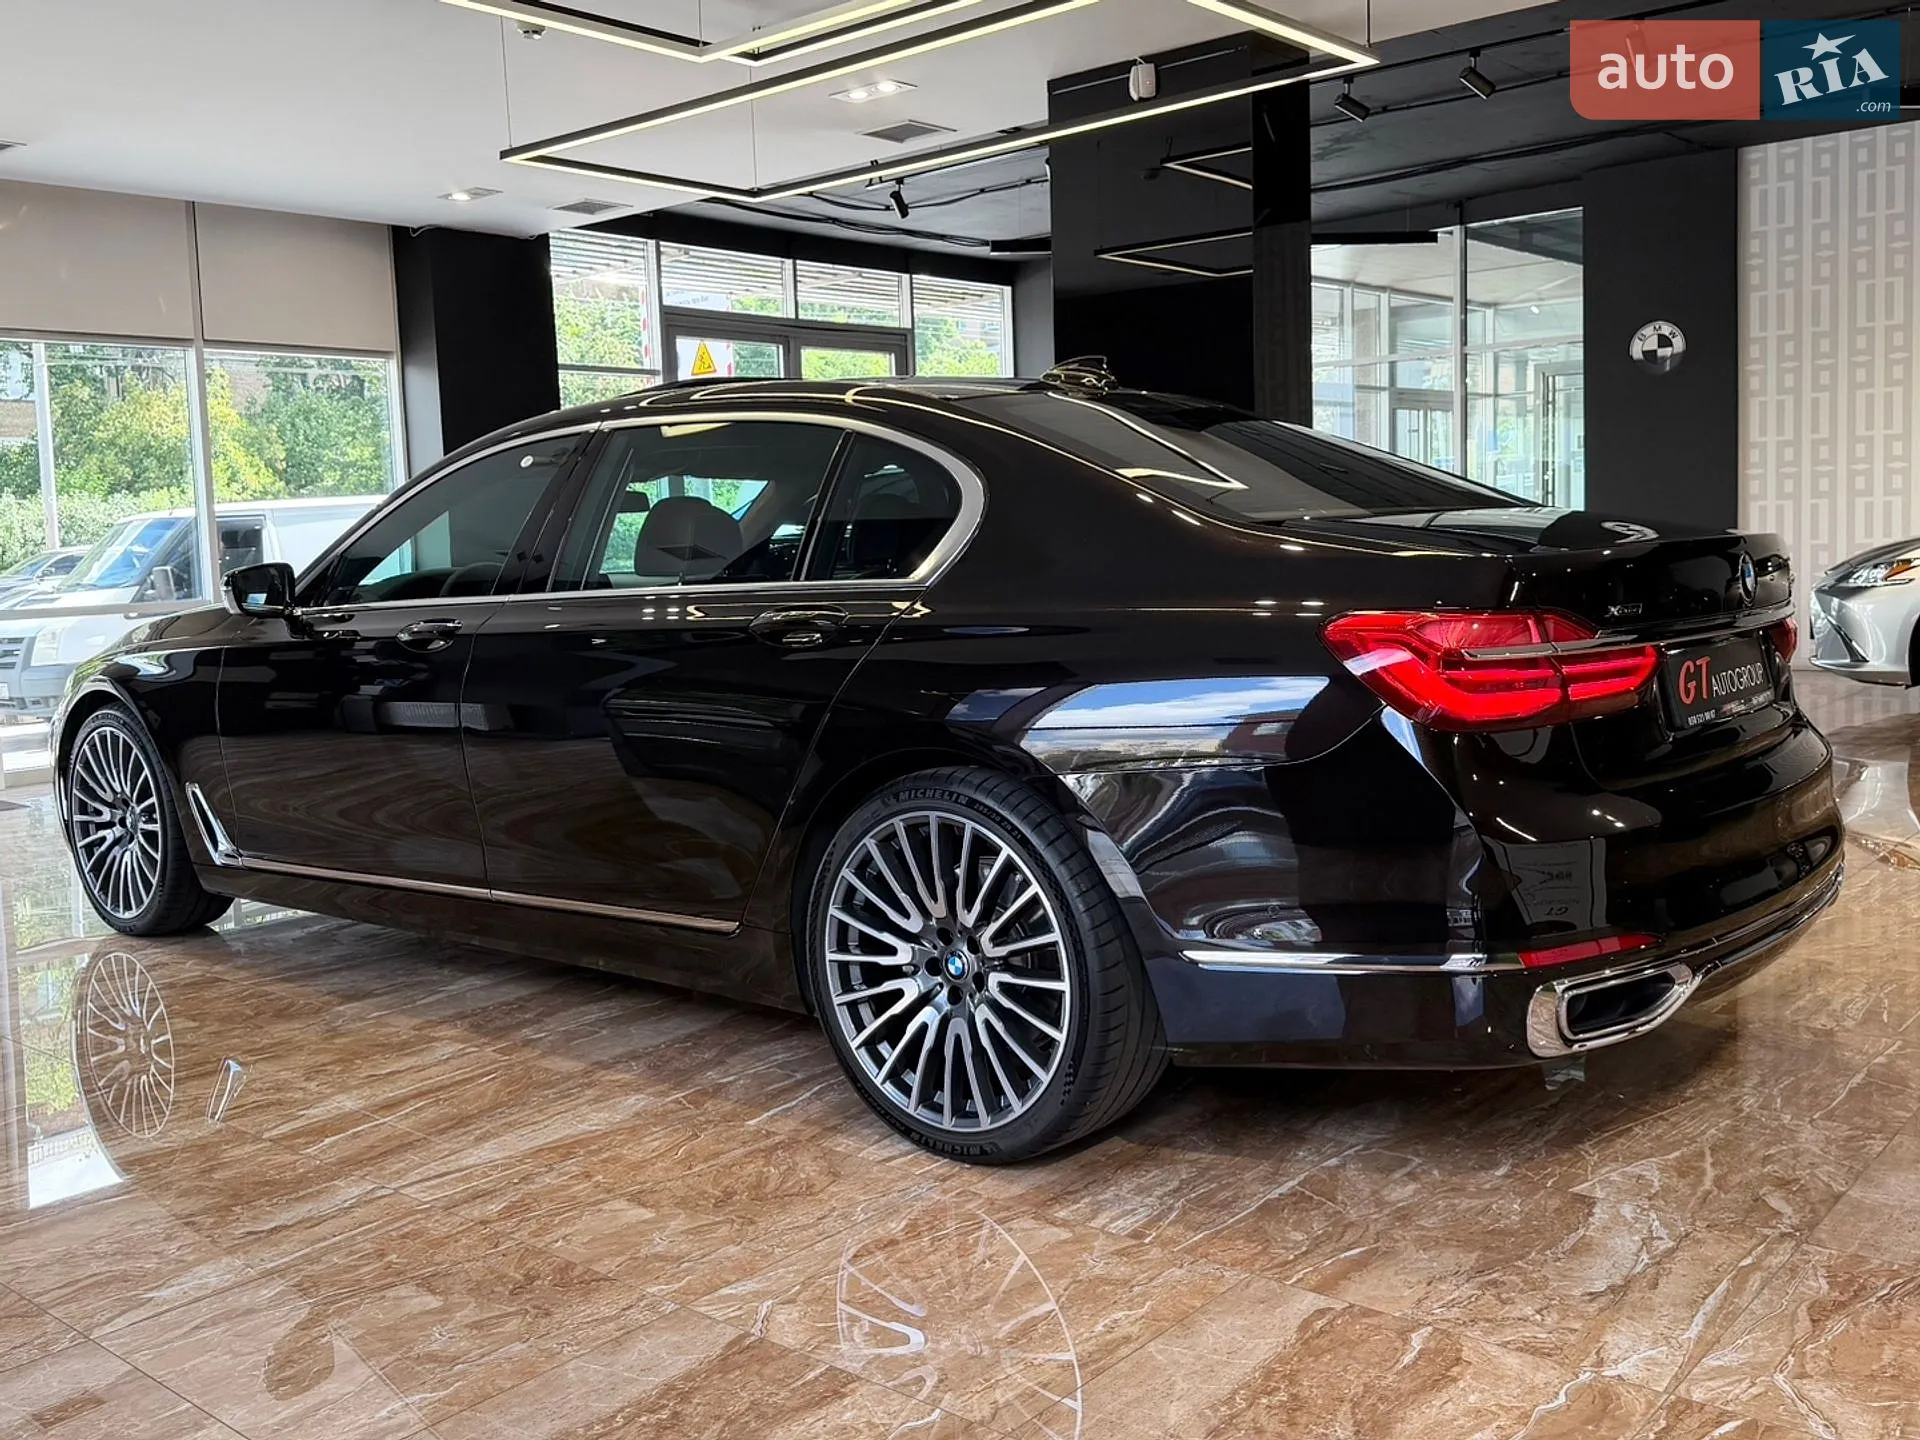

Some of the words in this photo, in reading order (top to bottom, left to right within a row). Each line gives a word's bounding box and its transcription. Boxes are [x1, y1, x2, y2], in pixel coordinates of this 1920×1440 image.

[1679, 656, 1711, 705] GT
[1711, 662, 1763, 698] AUTOGROUP
[899, 787, 969, 805] MICHELIN
